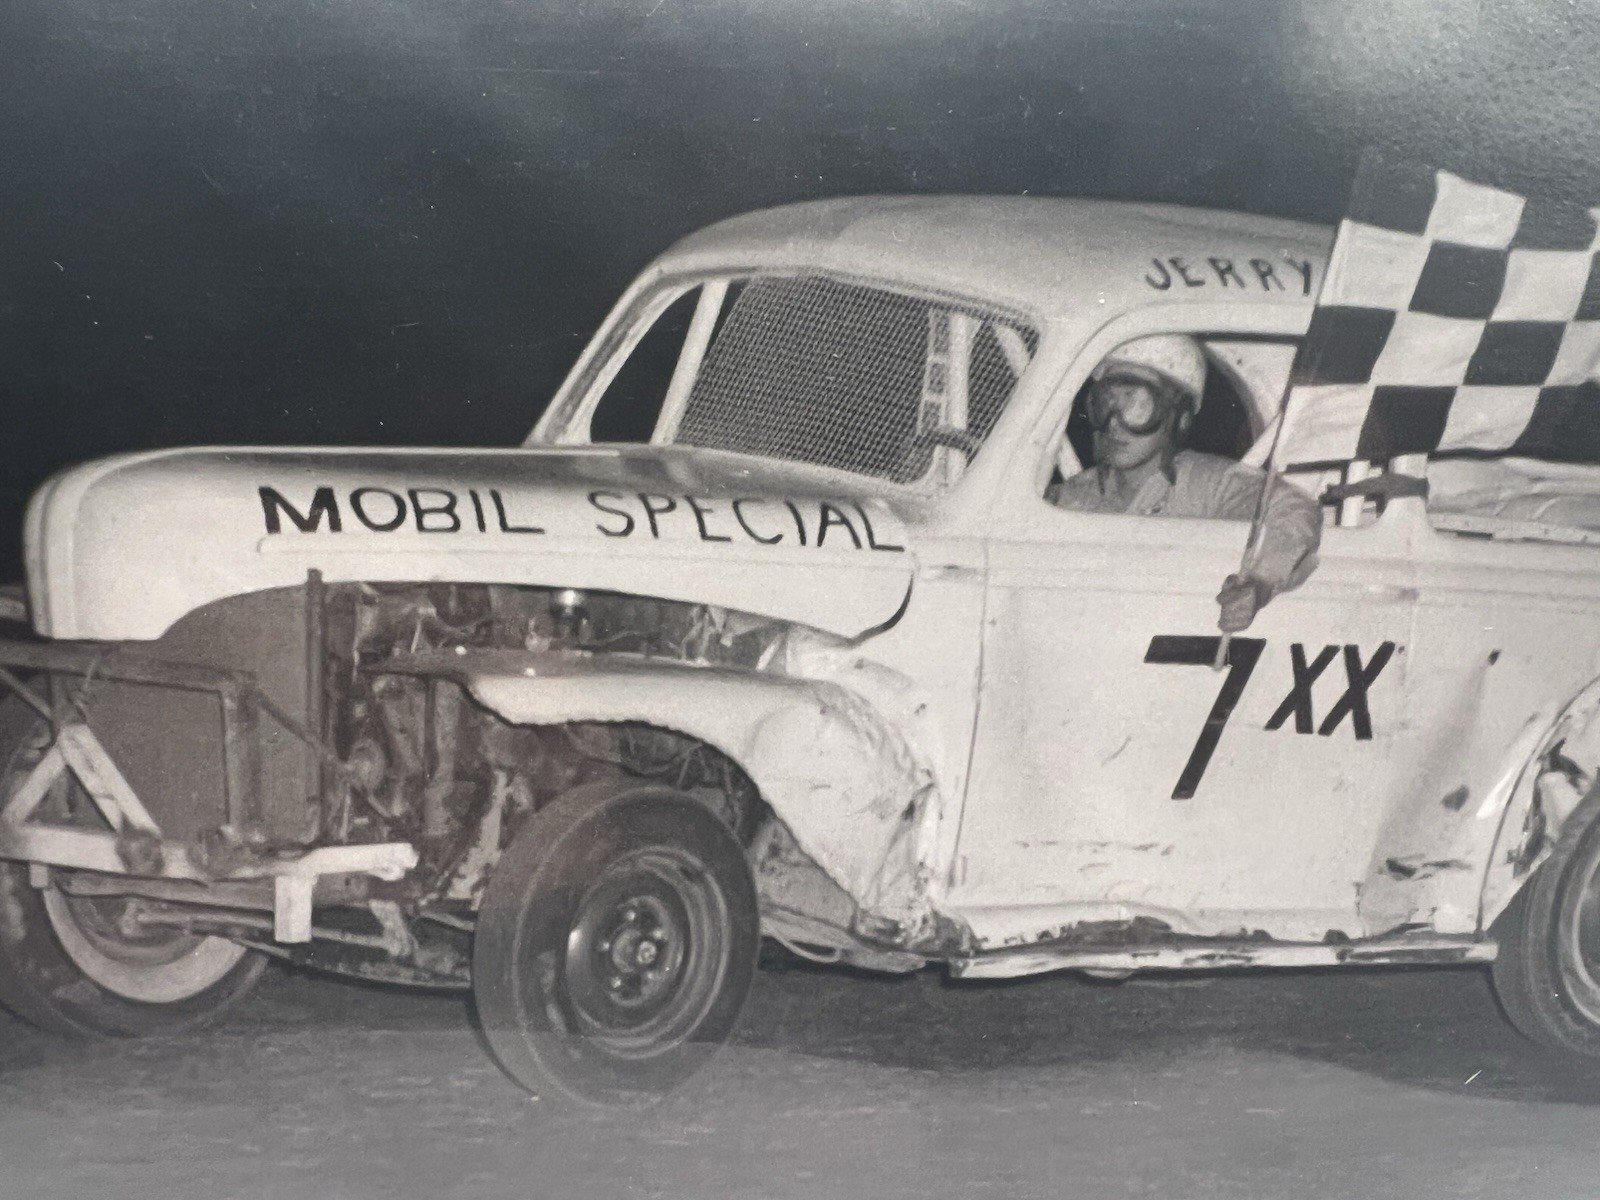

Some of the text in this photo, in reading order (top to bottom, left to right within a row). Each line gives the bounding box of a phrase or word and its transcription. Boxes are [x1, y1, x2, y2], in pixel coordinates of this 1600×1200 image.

[1145, 256, 1312, 297] JERRY
[258, 486, 905, 552] MOBIL SPECIAL
